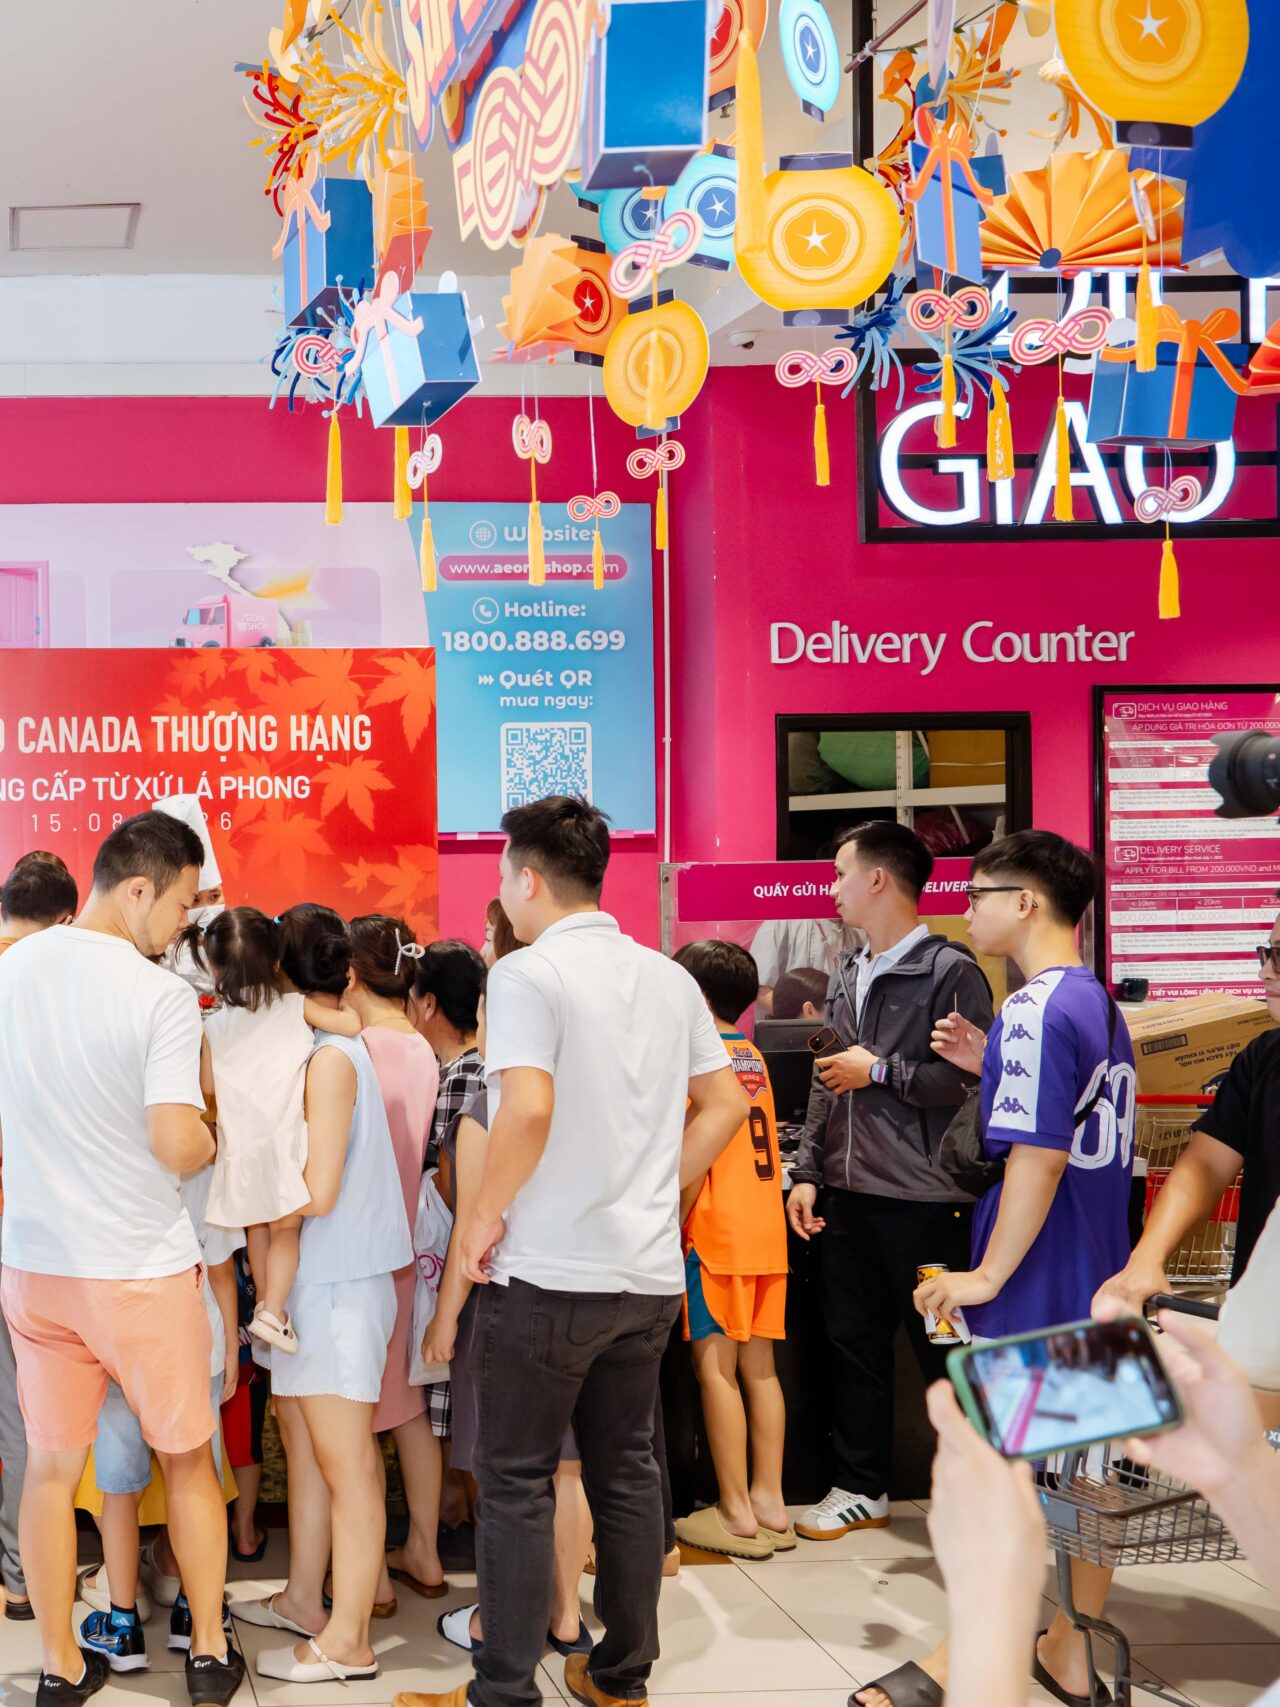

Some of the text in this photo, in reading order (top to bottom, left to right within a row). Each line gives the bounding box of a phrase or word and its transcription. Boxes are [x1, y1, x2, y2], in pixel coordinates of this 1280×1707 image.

[504, 525, 597, 542] Wbsite:
[449, 560, 620, 576] www.aeoshop.cm
[505, 601, 587, 617] Hotline:
[442, 630, 626, 652] 1800.888.699
[770, 621, 1136, 675] Delivery Counter
[499, 669, 593, 688] Quét QR
[500, 694, 594, 710] mua ngay:
[1176, 702, 1199, 711] GIAO
[1201, 700, 1228, 711] HÀNG
[17, 715, 142, 754] CANADA
[151, 710, 278, 763] THƯỢNG
[289, 714, 373, 762] HẠNG
[31, 769, 86, 801] CẤP
[92, 772, 131, 801] TỪ
[134, 770, 174, 800] XỨ
[220, 774, 311, 800] PHONG
[31, 811, 233, 833] 15.0826
[1141, 844, 1221, 855] DELIVERY SERVICE
[1125, 866, 1151, 875] APPLY
[1151, 866, 1167, 874] FOR
[1169, 866, 1184, 874] BILL
[923, 881, 973, 894] ELIVER
[732, 1058, 764, 1073] HAMPION
[749, 1106, 775, 1181] 9
